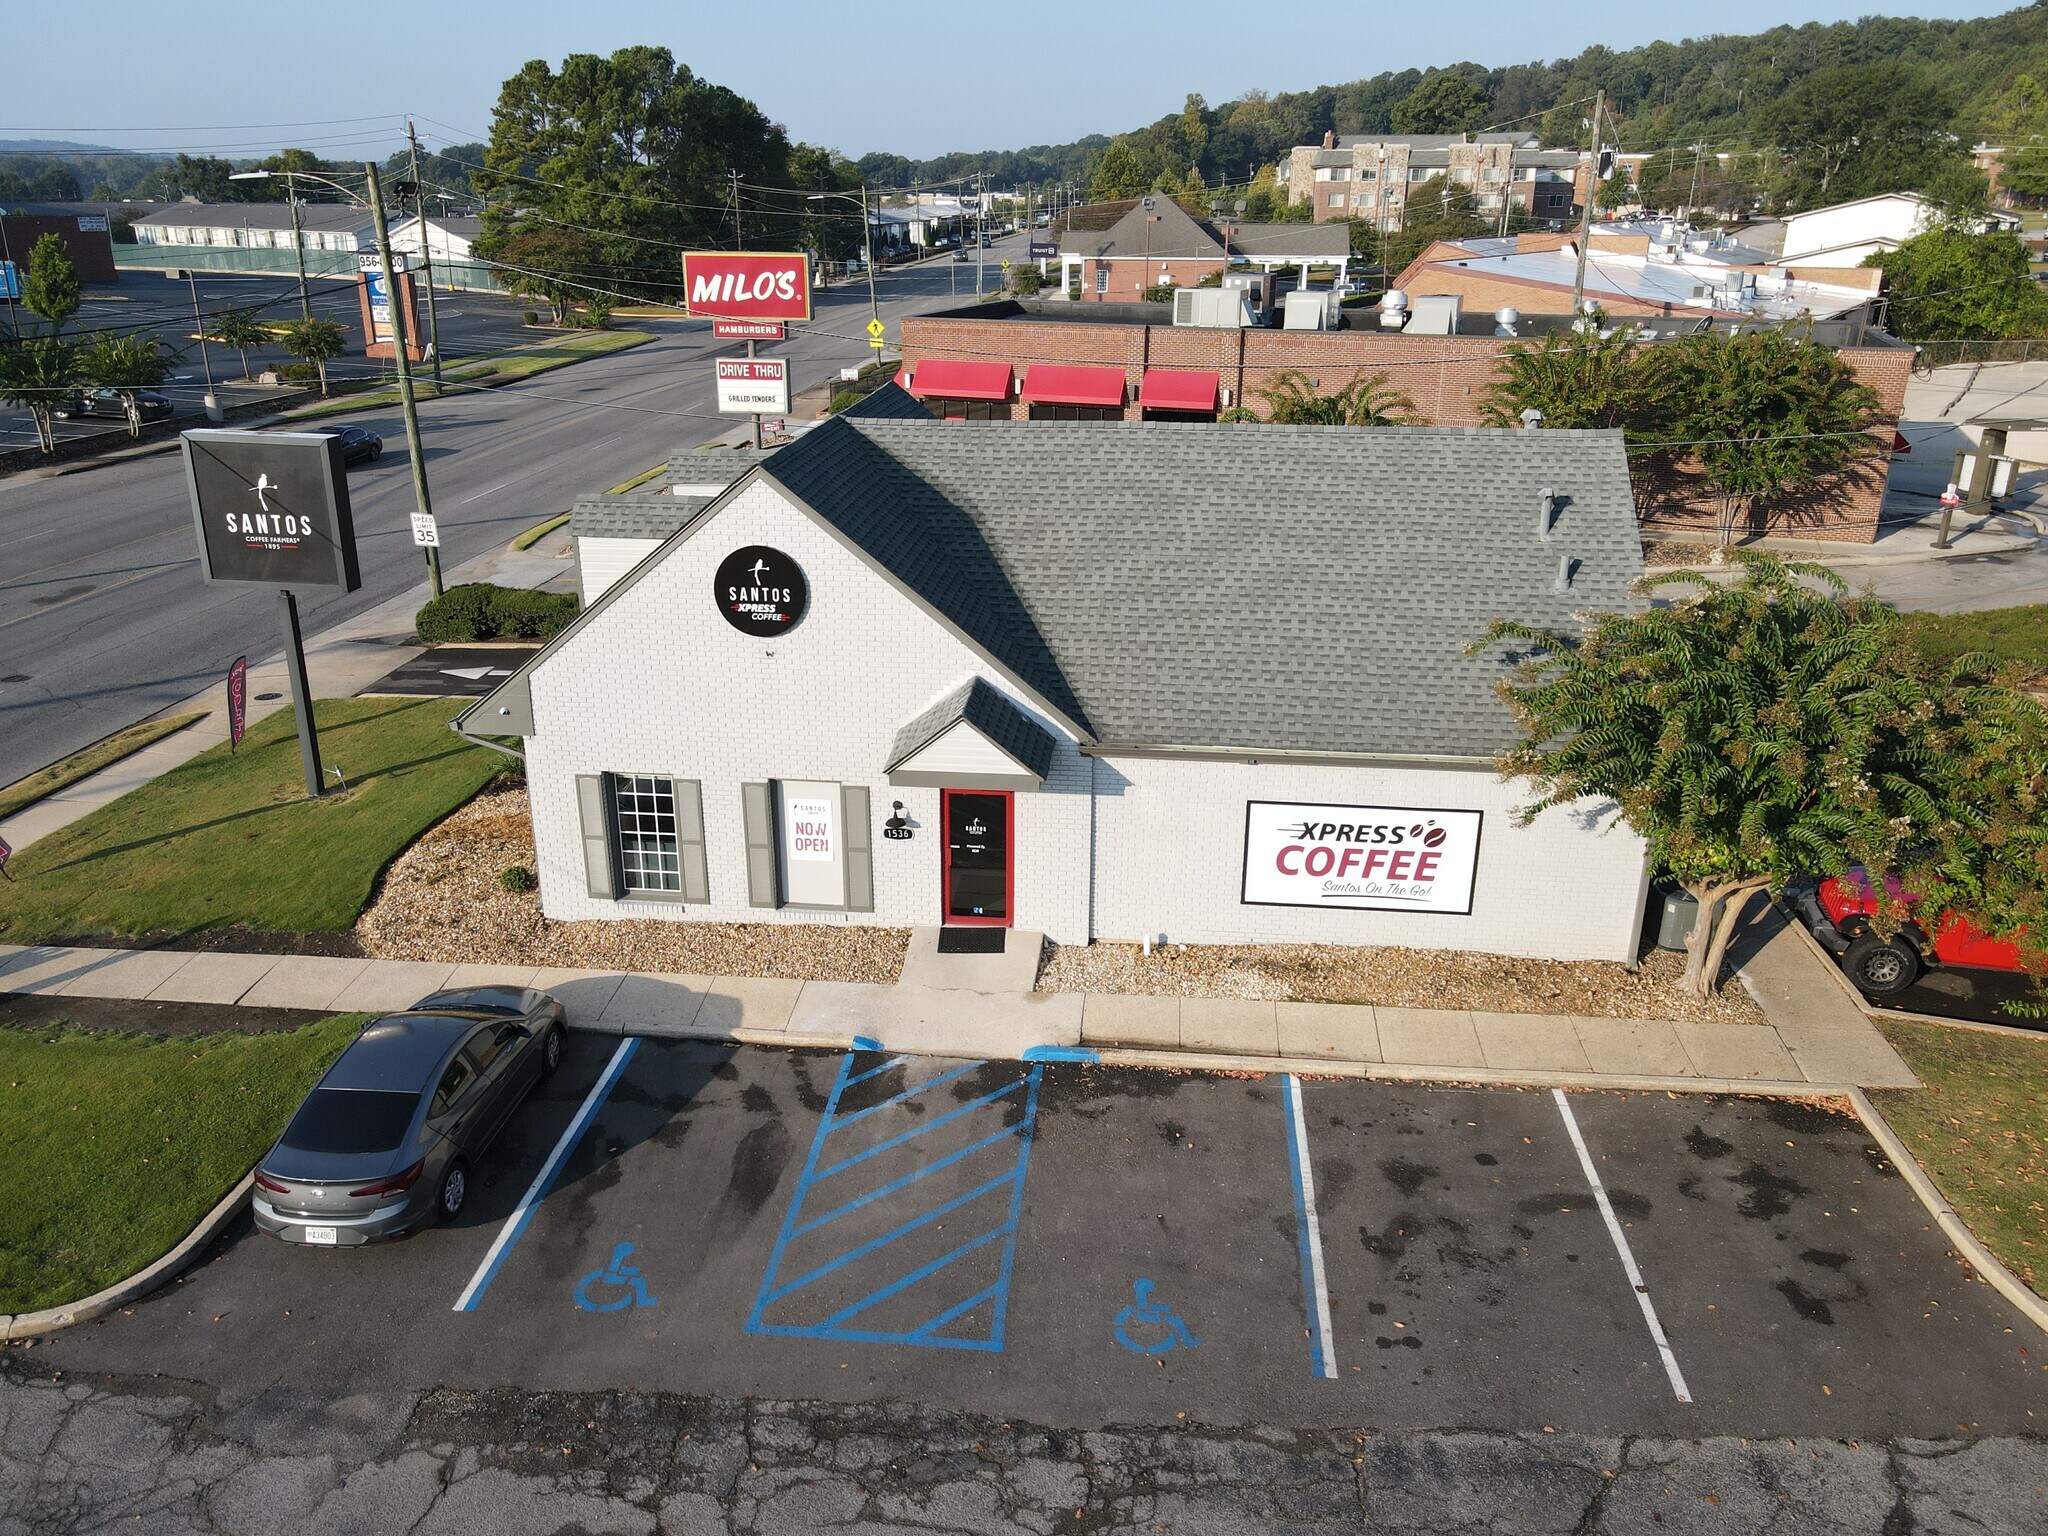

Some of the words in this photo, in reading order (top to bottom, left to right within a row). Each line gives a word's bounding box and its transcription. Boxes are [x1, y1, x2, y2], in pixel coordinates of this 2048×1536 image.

[359, 256, 403, 267] 956-00
[692, 270, 797, 303] MILO'S
[718, 325, 778, 335] HAMBURGERS
[719, 364, 750, 377] DRIVE
[753, 365, 782, 378] THRU
[751, 395, 776, 403] TENDERS
[225, 512, 312, 536] SANTOS
[417, 530, 435, 542] 35
[729, 586, 791, 603] SANTOS
[737, 603, 776, 613] XPRESS
[751, 613, 782, 621] COFFEE
[795, 822, 827, 836] NOW
[887, 829, 909, 838] 1536
[1298, 822, 1406, 845] XPRESS
[795, 838, 829, 852] OPEN
[1275, 845, 1443, 882] COFFEE
[1321, 880, 1361, 894] Santos
[1365, 882, 1382, 895] On
[1386, 883, 1407, 896] The
[1409, 886, 1433, 897] Go!
